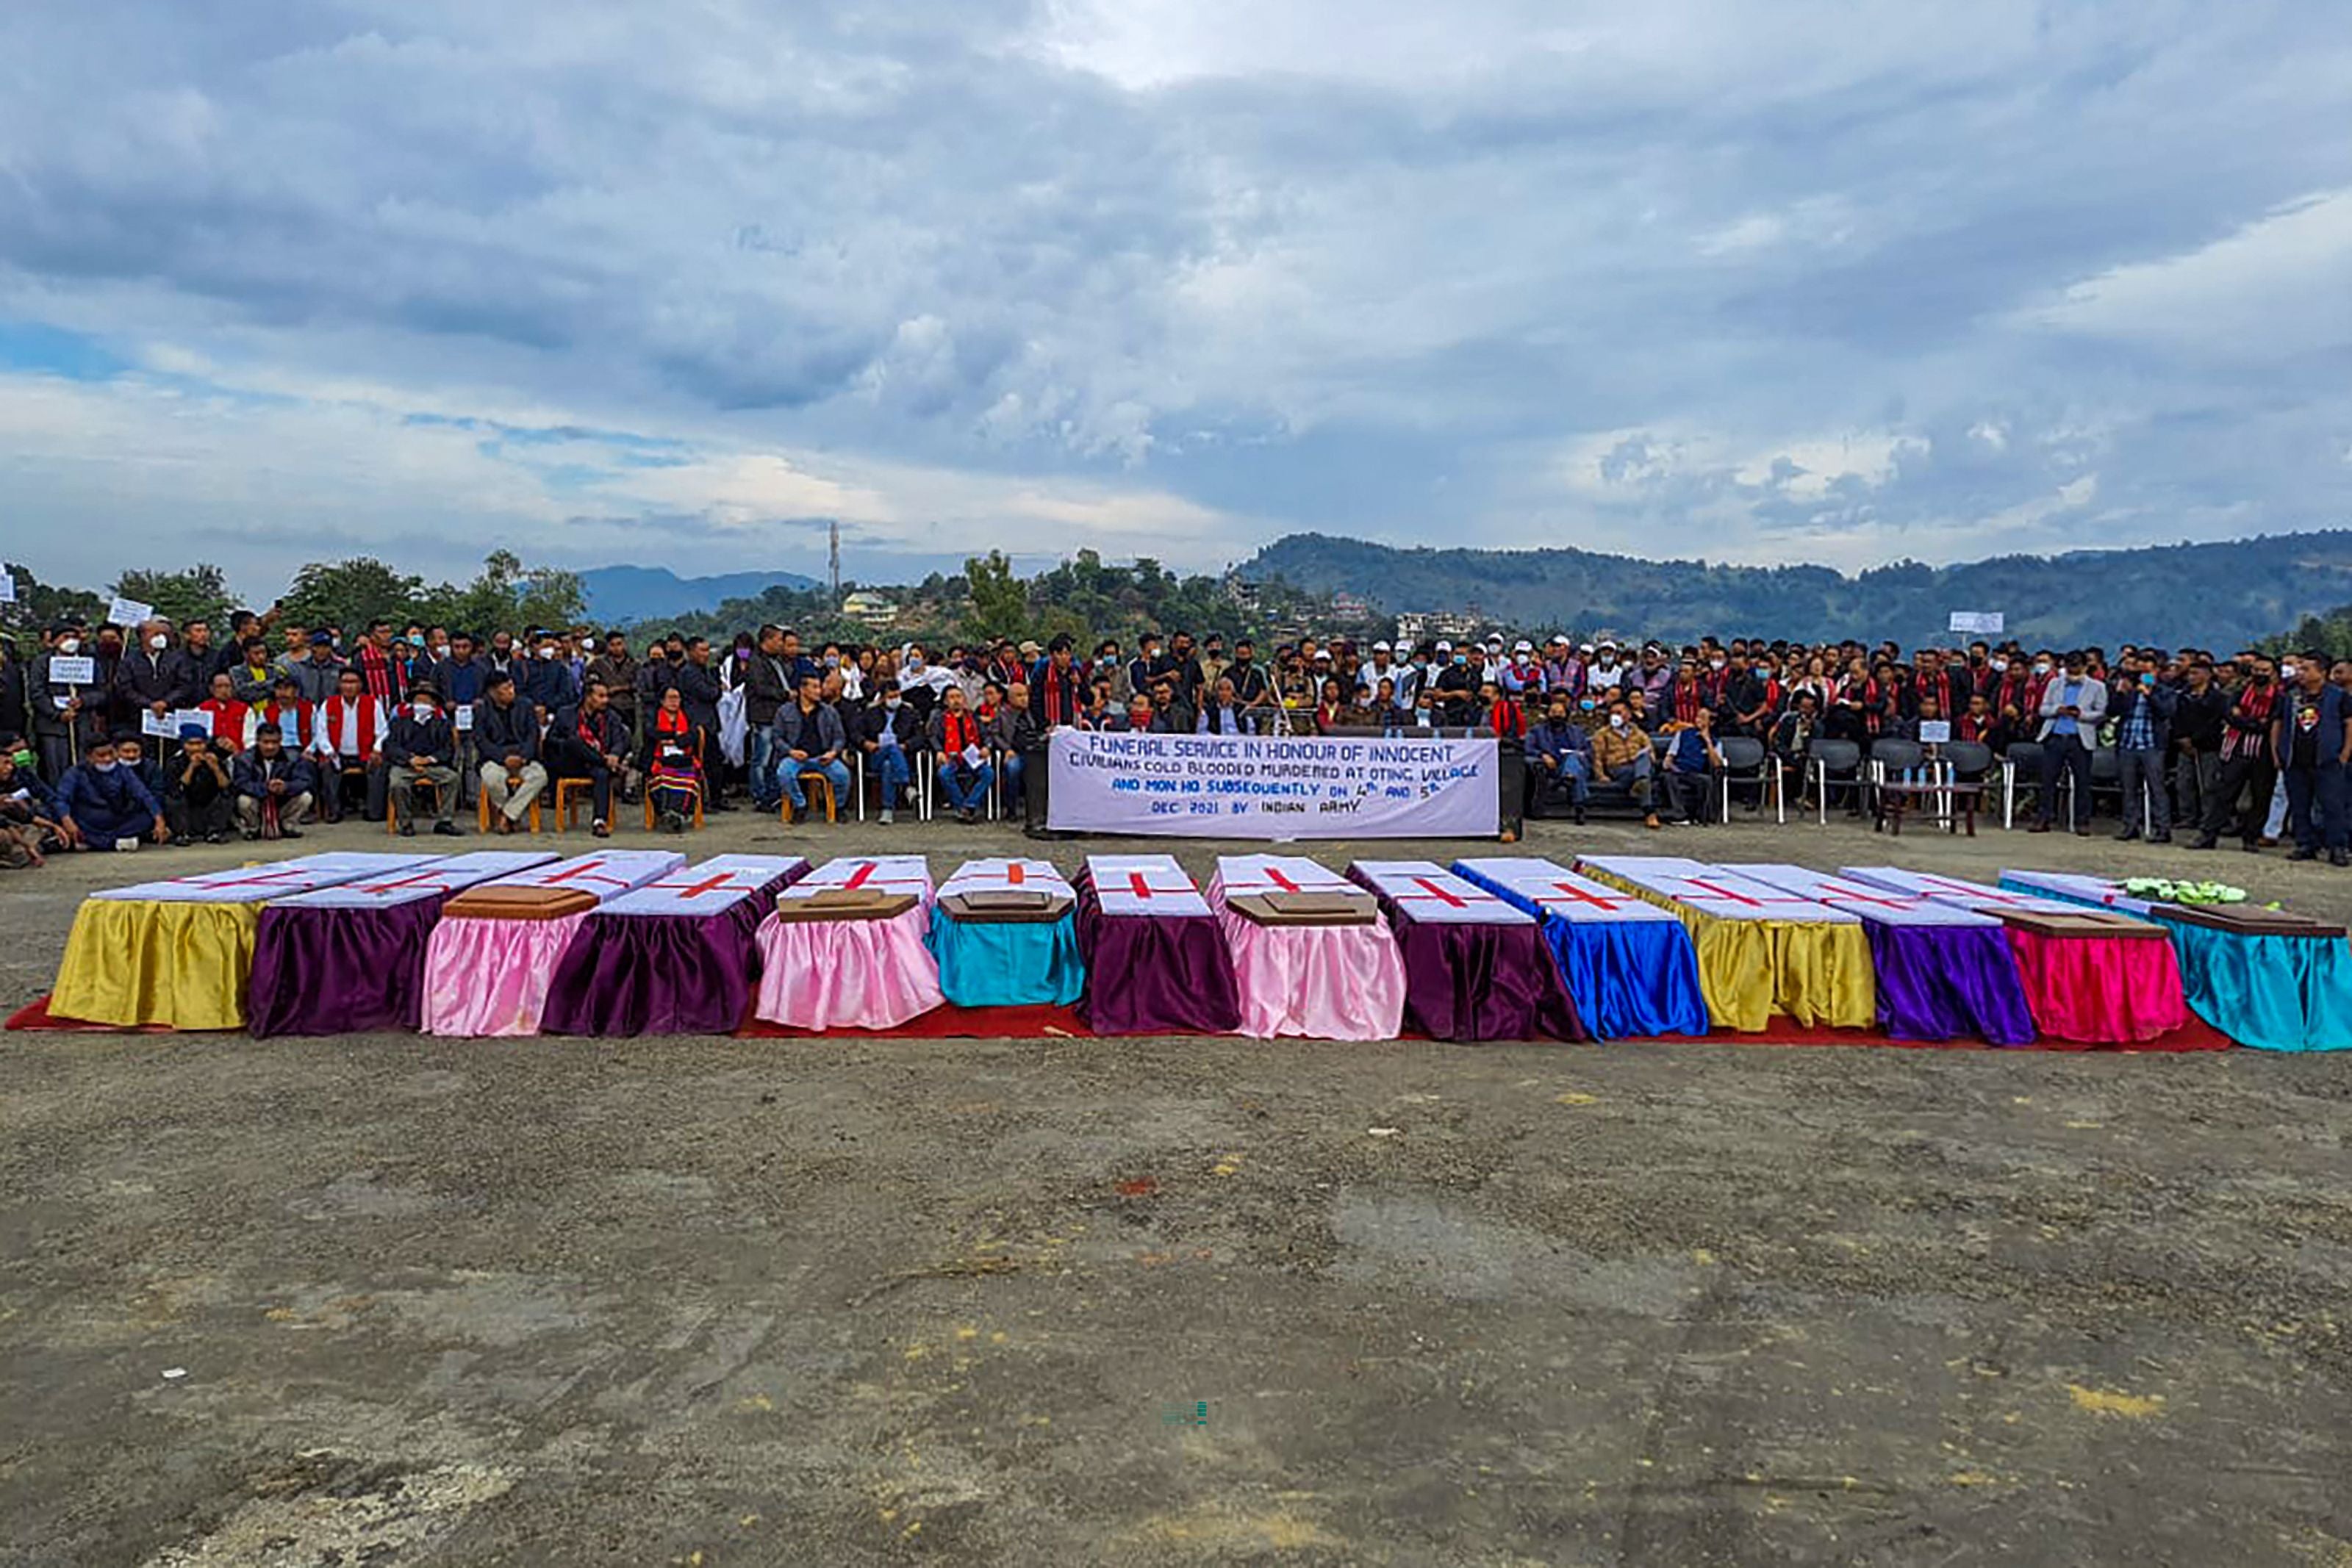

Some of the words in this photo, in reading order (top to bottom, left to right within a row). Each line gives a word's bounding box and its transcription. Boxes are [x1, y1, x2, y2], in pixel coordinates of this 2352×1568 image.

[1090, 736, 1167, 756] FUNERAL
[1175, 740, 1238, 758] SERVICE
[1244, 742, 1262, 758] IN
[1267, 743, 1336, 760] HONOUR
[1341, 745, 1363, 761] OF
[1369, 745, 1455, 763] INNOCENT
[1144, 761, 1182, 773] COLD
[1188, 761, 1255, 777] BLOODED
[1261, 763, 1340, 780] MURDERED
[1346, 766, 1365, 779] AT
[1112, 778, 1139, 791] AND
[1145, 780, 1177, 792] MON
[1329, 786, 1347, 797] ON
[1385, 785, 1410, 798] AND
[1151, 801, 1179, 813] DEC
[1190, 801, 1219, 814] 2021
[1231, 802, 1249, 814] BY
[1261, 800, 1305, 813] INDIAN
[1319, 798, 1361, 813] ARMY
